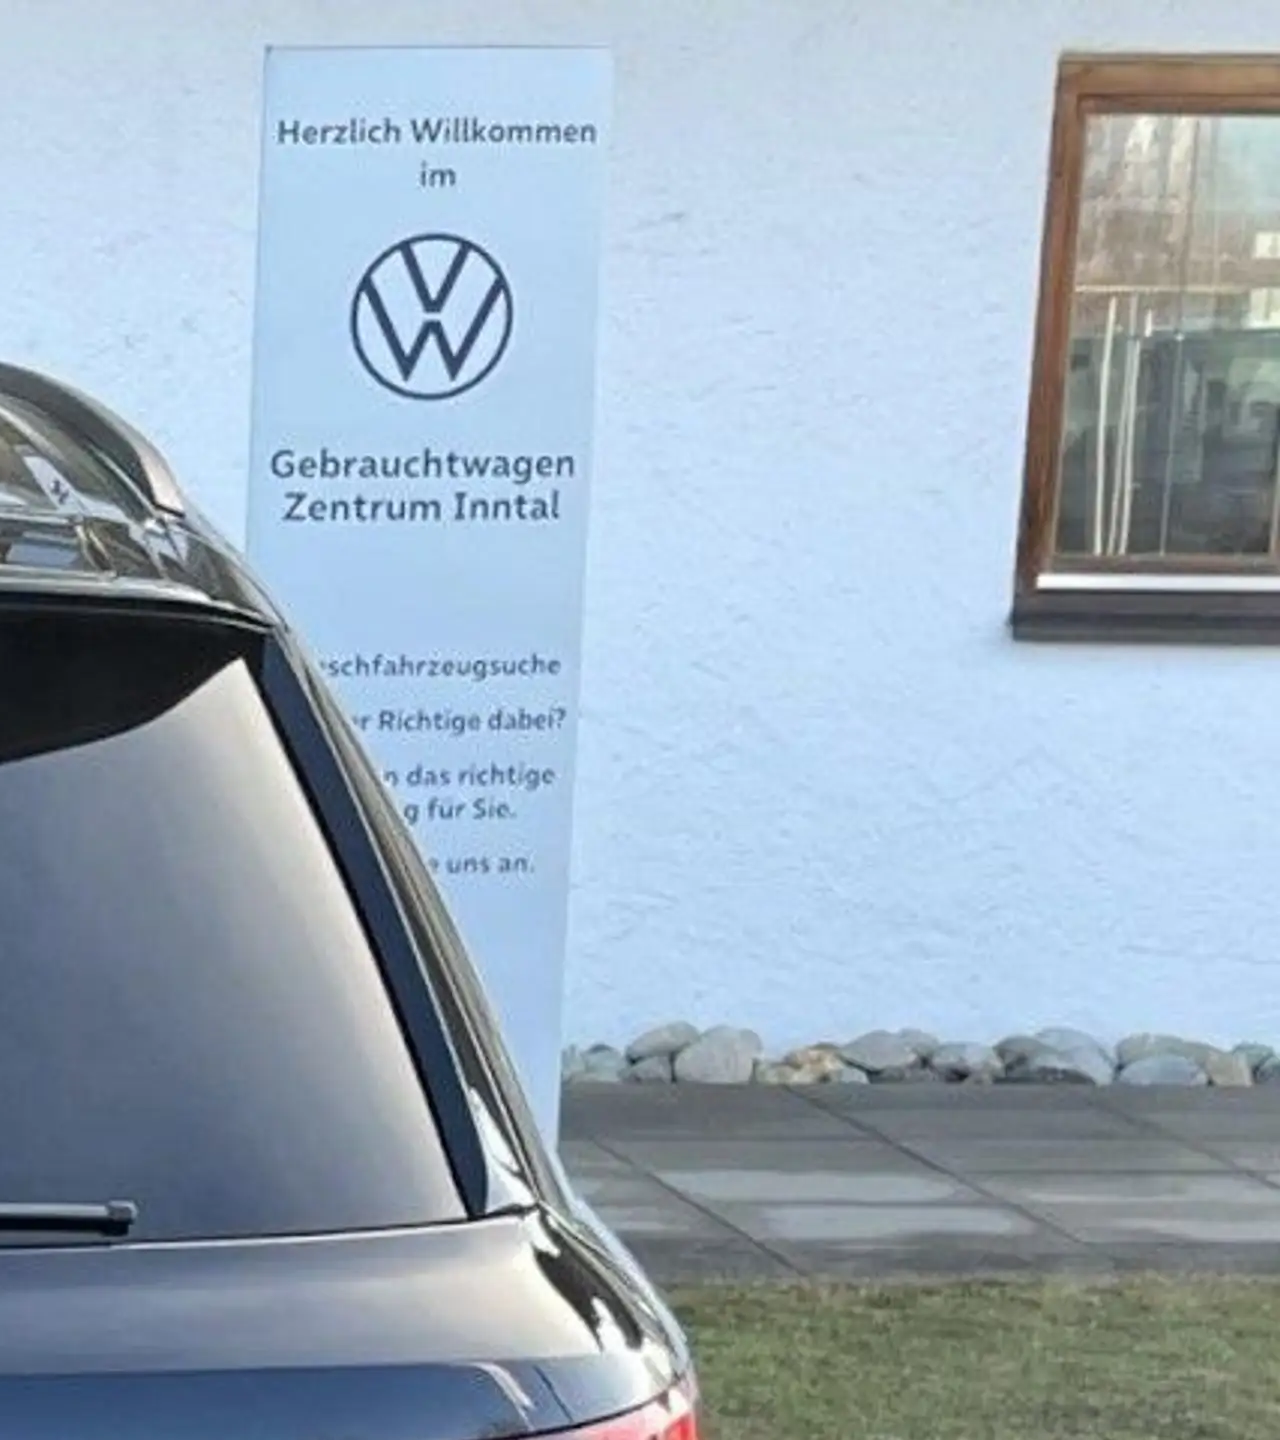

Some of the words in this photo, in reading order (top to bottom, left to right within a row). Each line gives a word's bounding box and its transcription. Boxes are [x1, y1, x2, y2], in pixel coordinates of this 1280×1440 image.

[277, 119, 401, 144] Herzlich
[410, 119, 597, 144] Willkommen
[419, 161, 457, 187] im
[350, 233, 513, 400] VW
[270, 450, 575, 485] Gebrauchtwagen
[283, 492, 441, 522] Zentrum
[453, 492, 560, 521] Inntal
[321, 654, 562, 681] schfahrzeugsuche
[378, 708, 481, 736] Richtige
[487, 707, 567, 730] dabei?
[406, 764, 451, 785] das
[458, 764, 555, 790] richtige
[473, 798, 517, 820] Sie.
[447, 855, 491, 874] uns
[497, 855, 535, 874] an.
